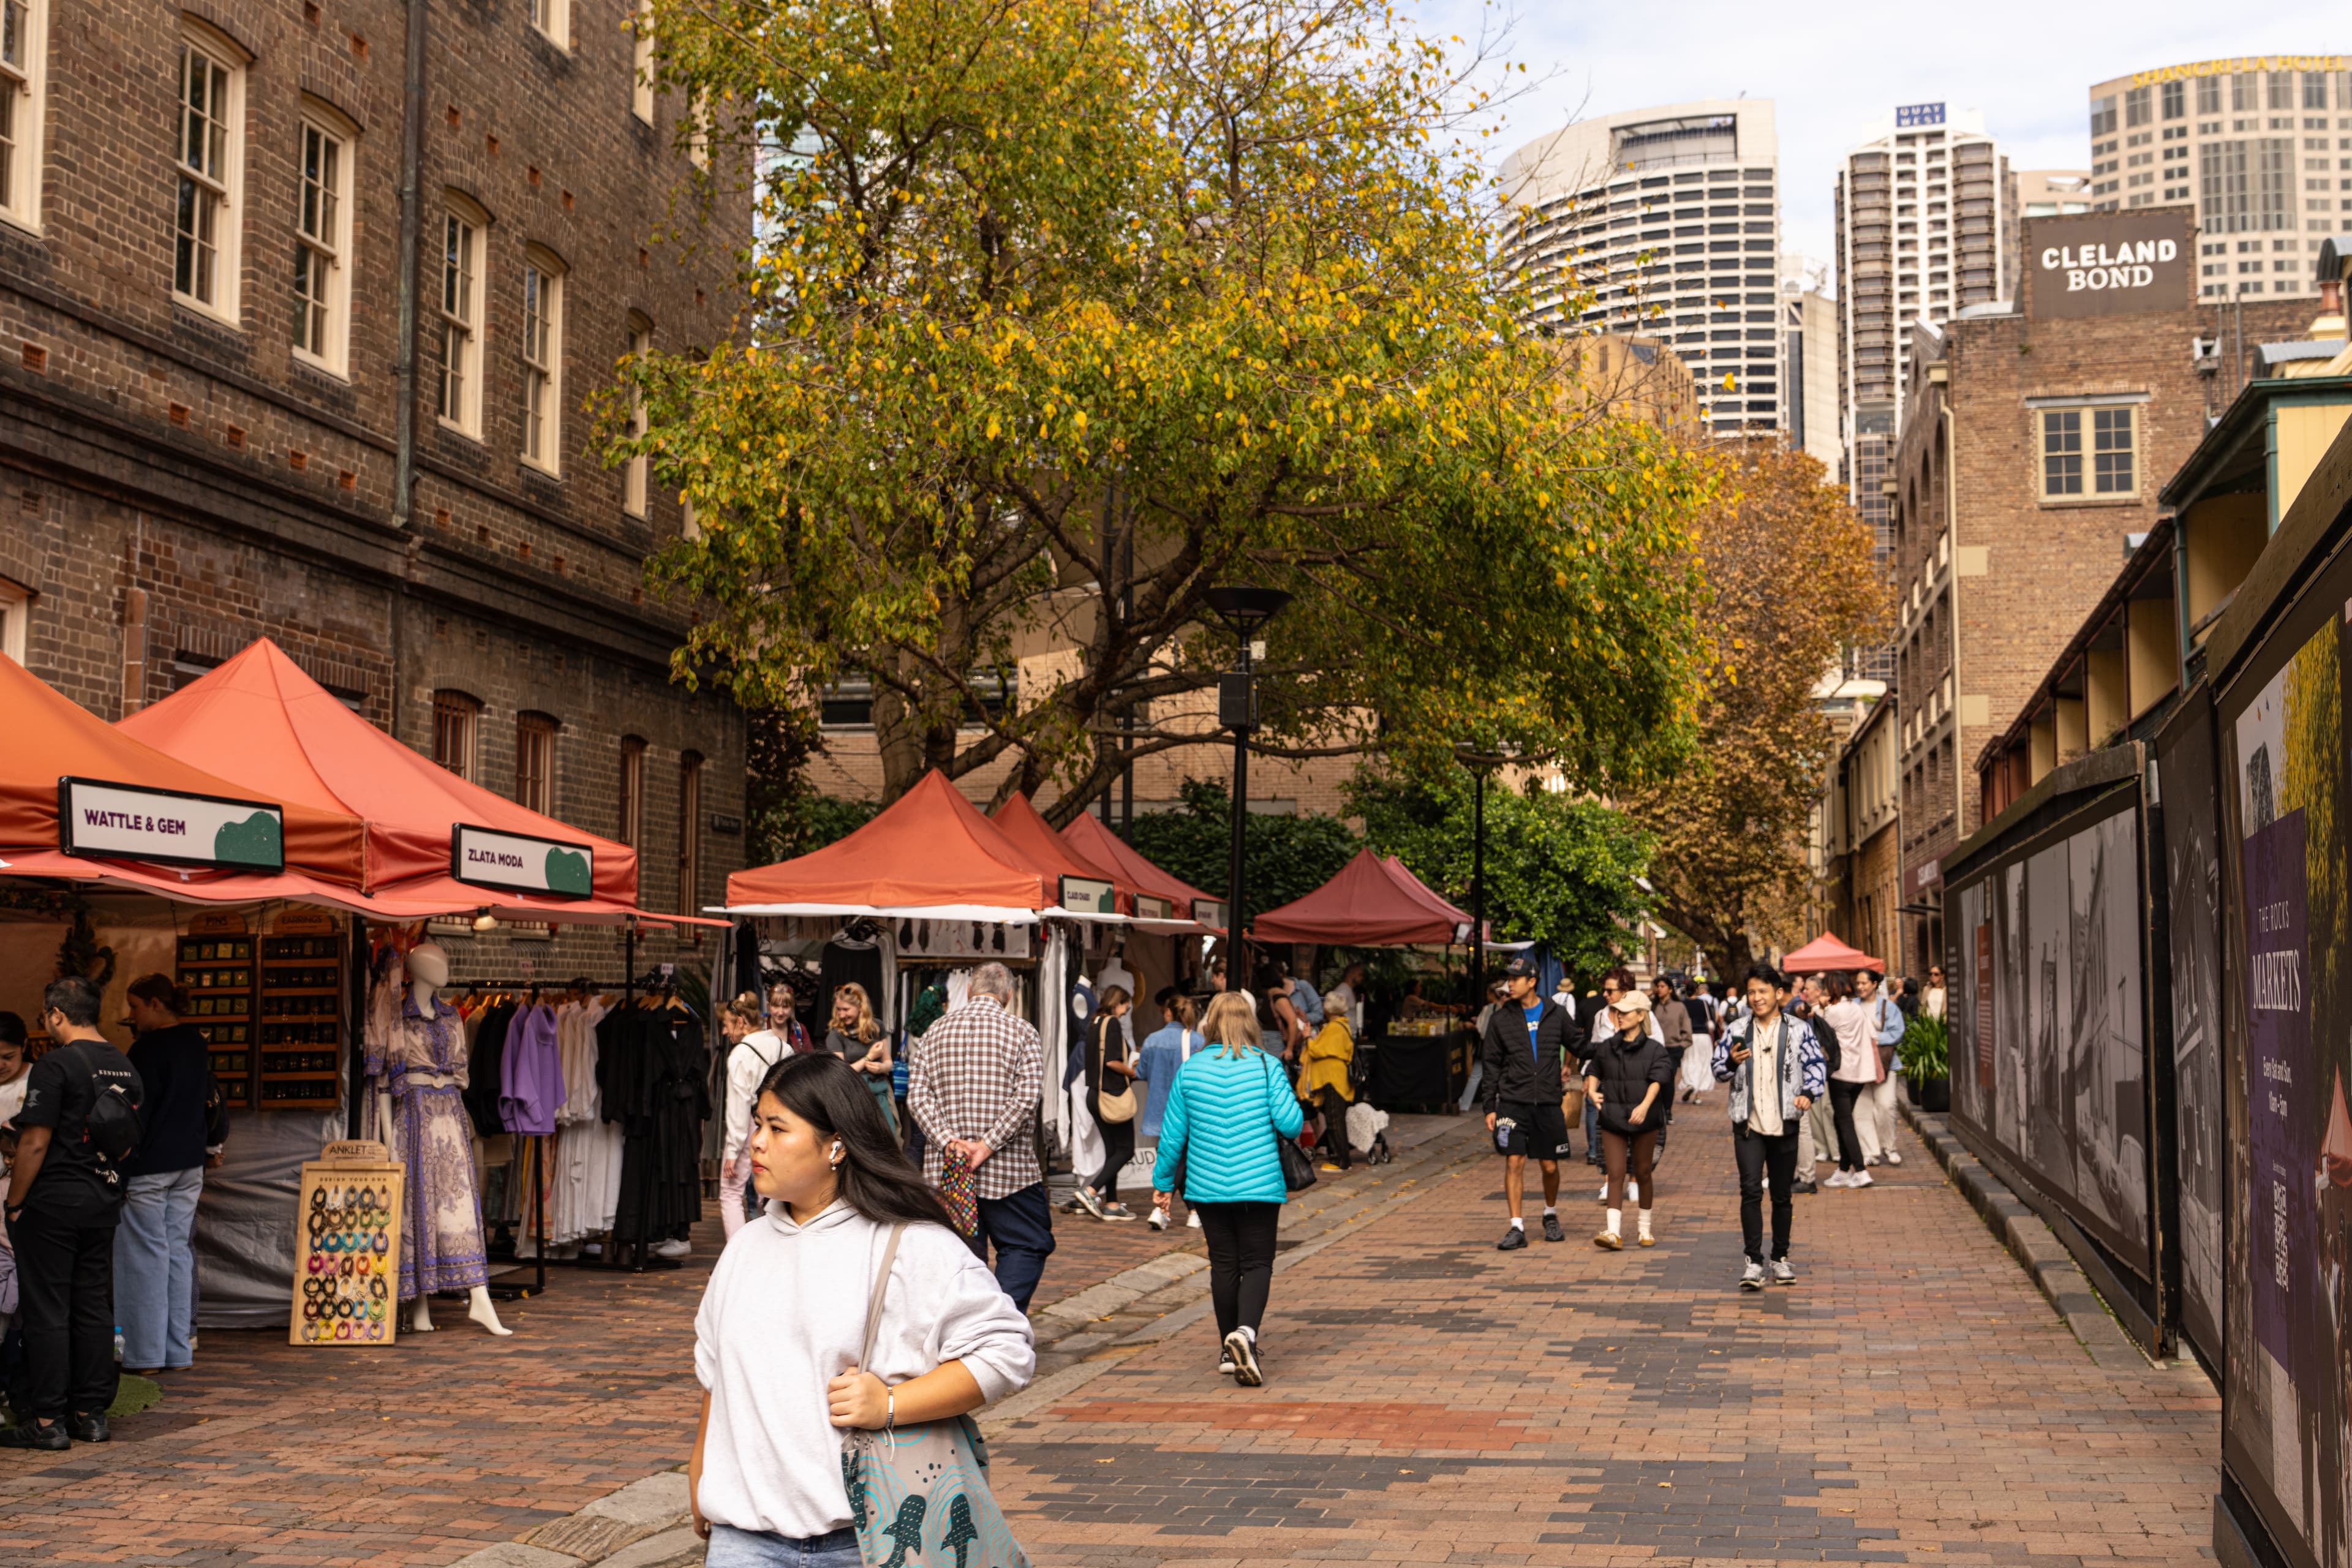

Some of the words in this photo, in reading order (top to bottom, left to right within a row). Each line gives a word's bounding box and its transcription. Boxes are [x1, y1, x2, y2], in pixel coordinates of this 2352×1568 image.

[2132, 56, 2269, 89] SHANGRI-LA
[2277, 55, 2346, 72] HOTEL
[1899, 104, 1940, 116] QUAY
[1901, 115, 1940, 126] WEST
[2041, 238, 2177, 270] CLELAND
[2066, 265, 2154, 292] BOND
[84, 809, 142, 831] WATTLE
[146, 818, 154, 832] &
[158, 818, 186, 835] GEM
[468, 848, 496, 865] ZLATA
[498, 852, 524, 869] MODA
[206, 916, 227, 926] PINS
[282, 916, 323, 924] EARRINGS
[2258, 906, 2269, 933] THE
[2271, 900, 2289, 931] ROCKS
[2252, 949, 2301, 1013] MARKETS
[329, 1145, 368, 1154] ANKLET
